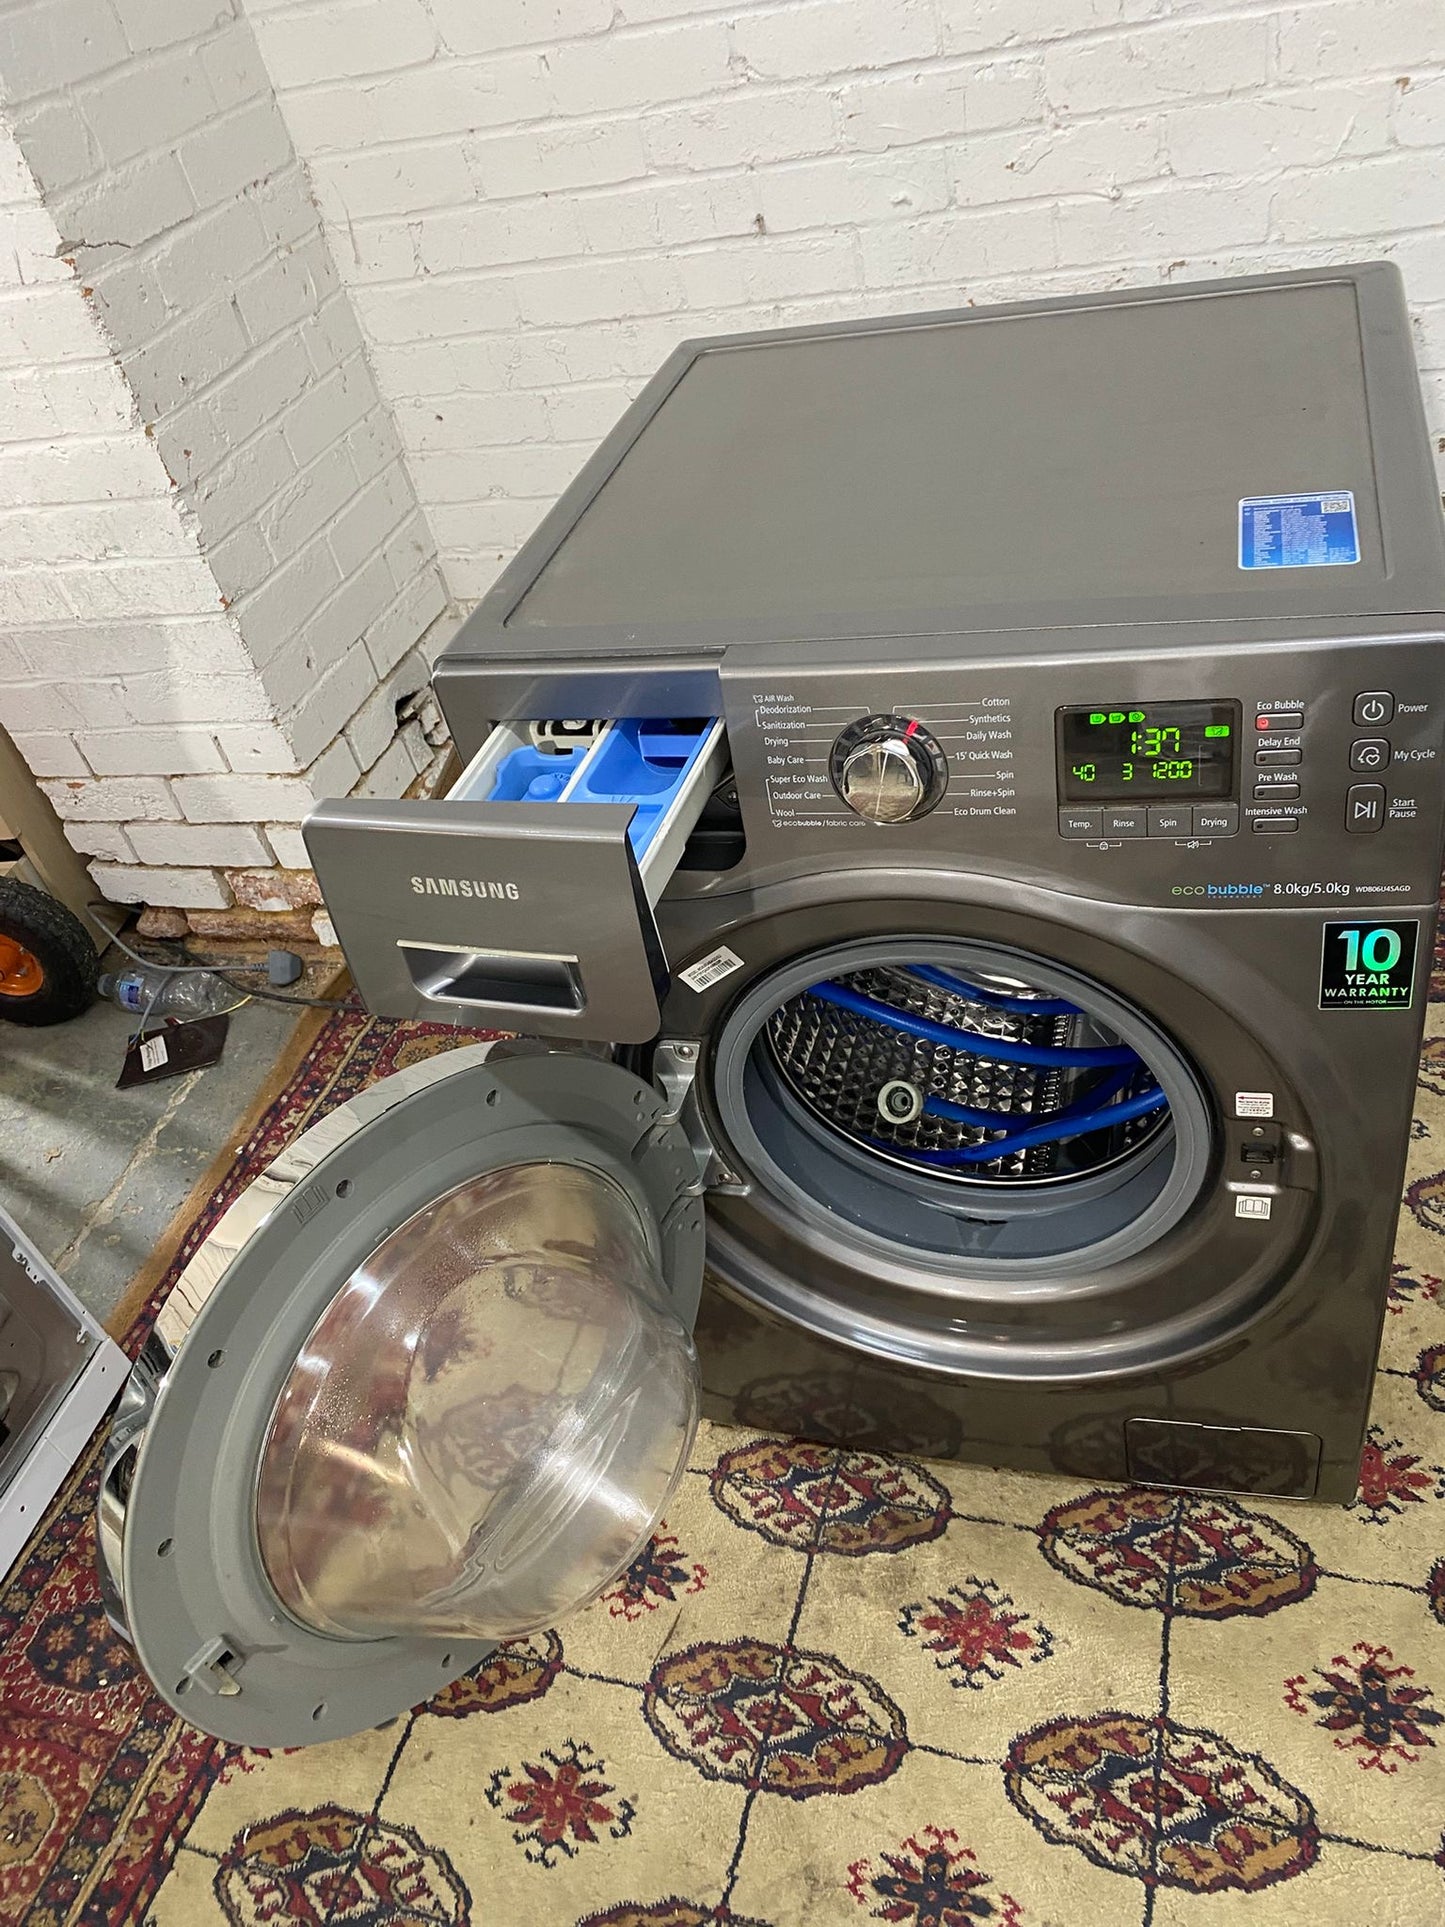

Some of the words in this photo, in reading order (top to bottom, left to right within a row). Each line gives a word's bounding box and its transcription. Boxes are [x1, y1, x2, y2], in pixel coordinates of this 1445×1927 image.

[981, 697, 1010, 707] Cotton
[1256, 702, 1272, 710] Eco
[1274, 700, 1305, 709] Bubble
[759, 705, 812, 714] Deodorization
[1397, 703, 1428, 713] Power
[969, 714, 1011, 725] Synthetics
[761, 721, 806, 730] Sanitization
[966, 731, 987, 742] Daily
[988, 729, 1012, 739] Wash
[764, 737, 789, 747] Drying
[1131, 727, 1180, 756] 1:37
[1258, 738, 1282, 748] Delay
[1283, 736, 1301, 746] End
[968, 751, 990, 760] Quick
[990, 750, 1013, 759] Wash
[1393, 751, 1410, 761] My
[1410, 749, 1436, 760] Cycle
[767, 756, 786, 766] Baby
[787, 756, 804, 764] Care
[1073, 764, 1096, 782] 40
[1122, 763, 1133, 780] 3
[1153, 760, 1193, 779] 1200
[770, 775, 791, 784] Super
[792, 775, 806, 783] Eco
[806, 774, 828, 783] Wash
[996, 771, 1014, 781] Spin
[1258, 773, 1273, 782] Pre
[1273, 773, 1298, 781] Wash
[772, 791, 802, 800] Outdoor
[803, 791, 821, 799] Care
[970, 787, 1015, 798] Rinse+Spin
[1392, 799, 1415, 807] Start
[775, 809, 795, 817] Wool
[953, 807, 968, 816] Eco
[969, 807, 991, 816] Drum
[993, 806, 1016, 815] Clean
[1245, 807, 1283, 816] Intensive
[1283, 806, 1308, 815] Wash
[1389, 809, 1417, 818] Pause
[1068, 820, 1093, 829] Temp.
[1113, 819, 1135, 828] Rinse
[1159, 819, 1177, 829] Spin
[1201, 818, 1228, 828] Drying
[410, 876, 520, 900] SAMSUNG
[1171, 886, 1206, 896] eco
[1273, 882, 1351, 897] 8.0kg/5.0kg
[1337, 928, 1401, 972] 10
[1345, 973, 1390, 986] YEAR
[1324, 986, 1409, 998] WARRANTY
